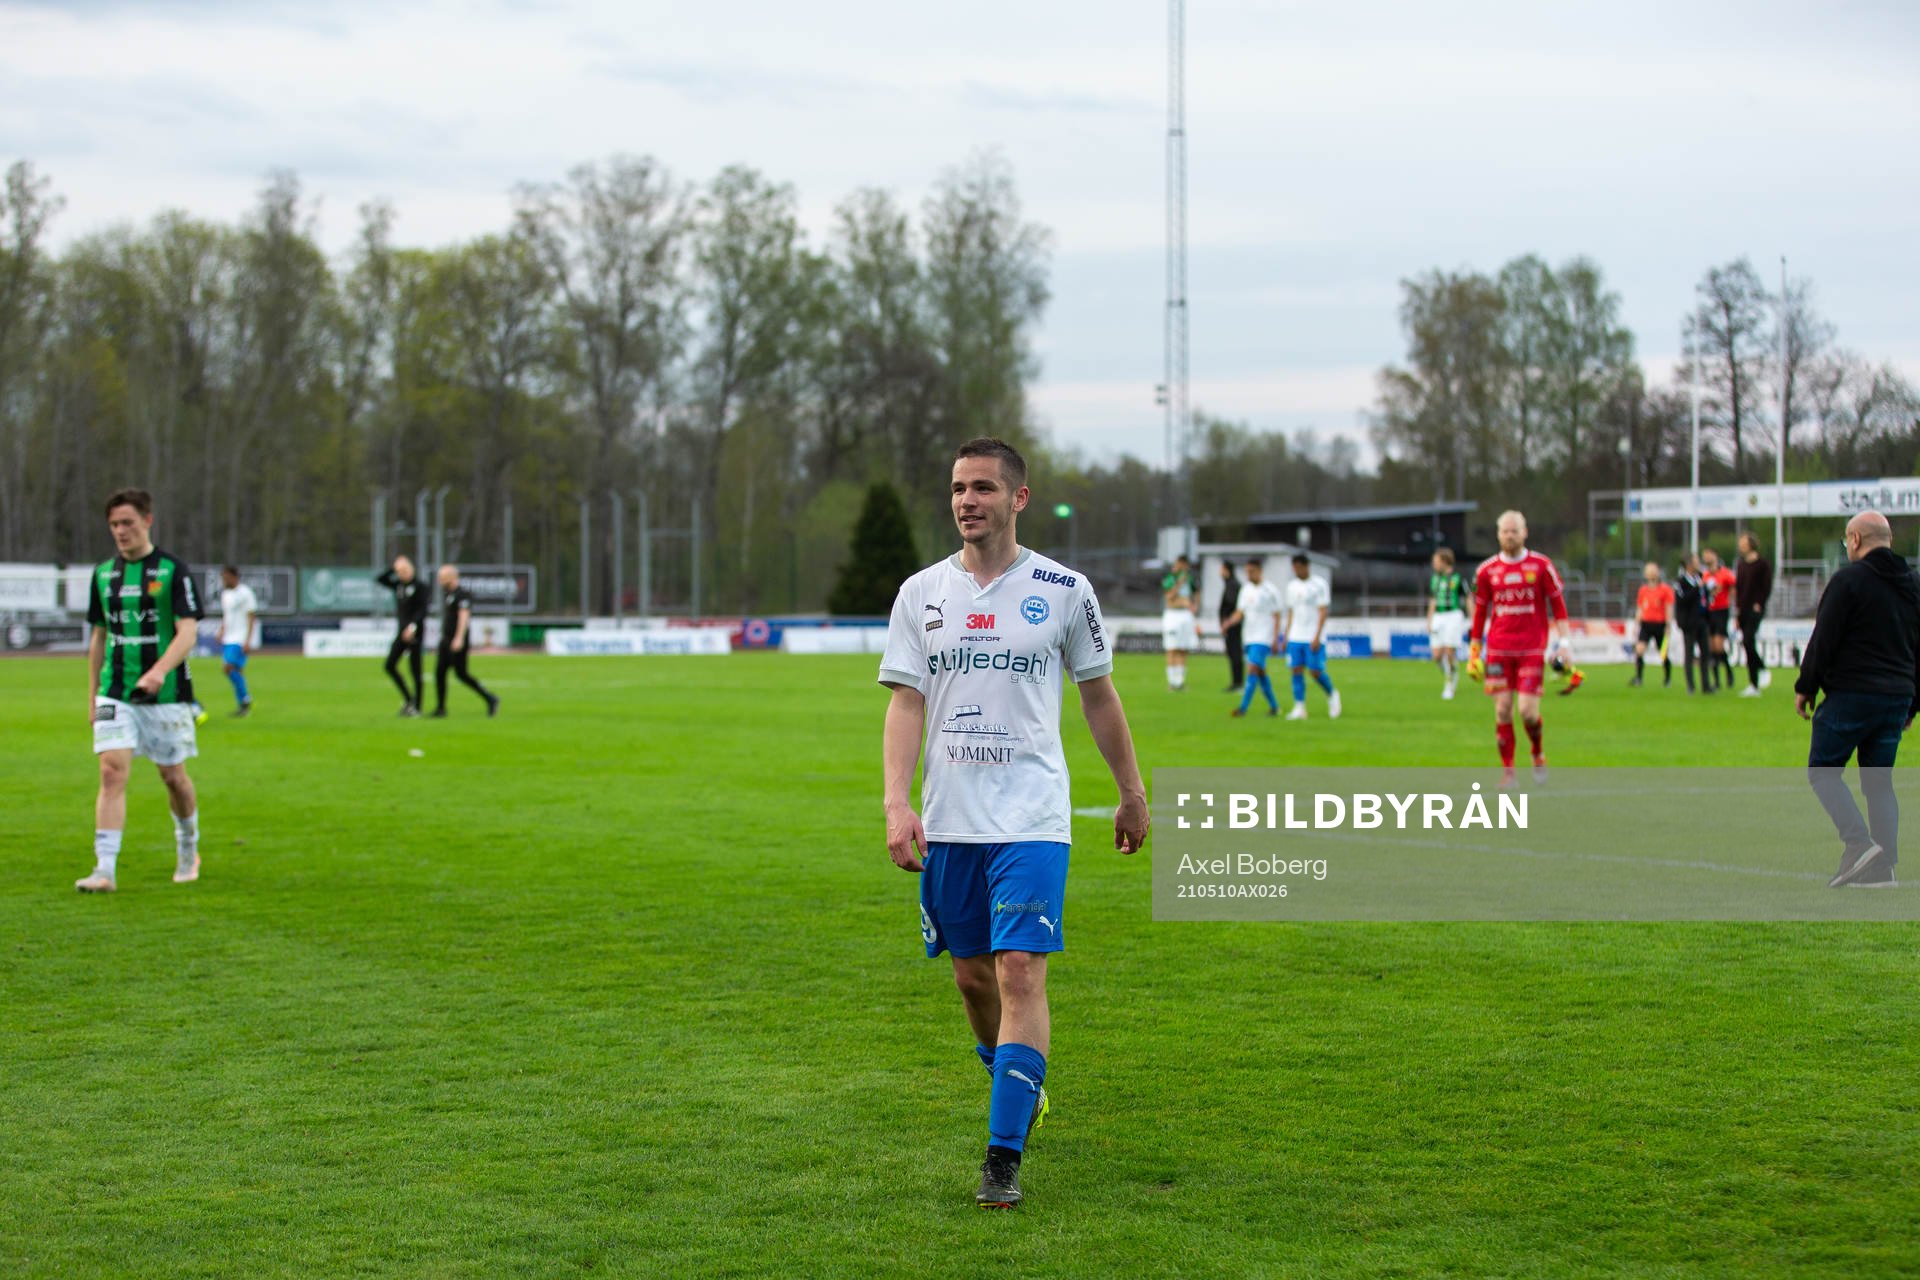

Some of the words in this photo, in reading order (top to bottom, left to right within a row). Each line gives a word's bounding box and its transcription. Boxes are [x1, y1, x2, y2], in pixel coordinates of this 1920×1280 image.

[1032, 568, 1077, 588] BUFAB
[966, 613, 995, 630] 3M
[1083, 598, 1105, 653] stadium
[940, 647, 1049, 677] Liljedahl
[1010, 673, 1046, 686] group
[947, 745, 1015, 763] NOMINIT
